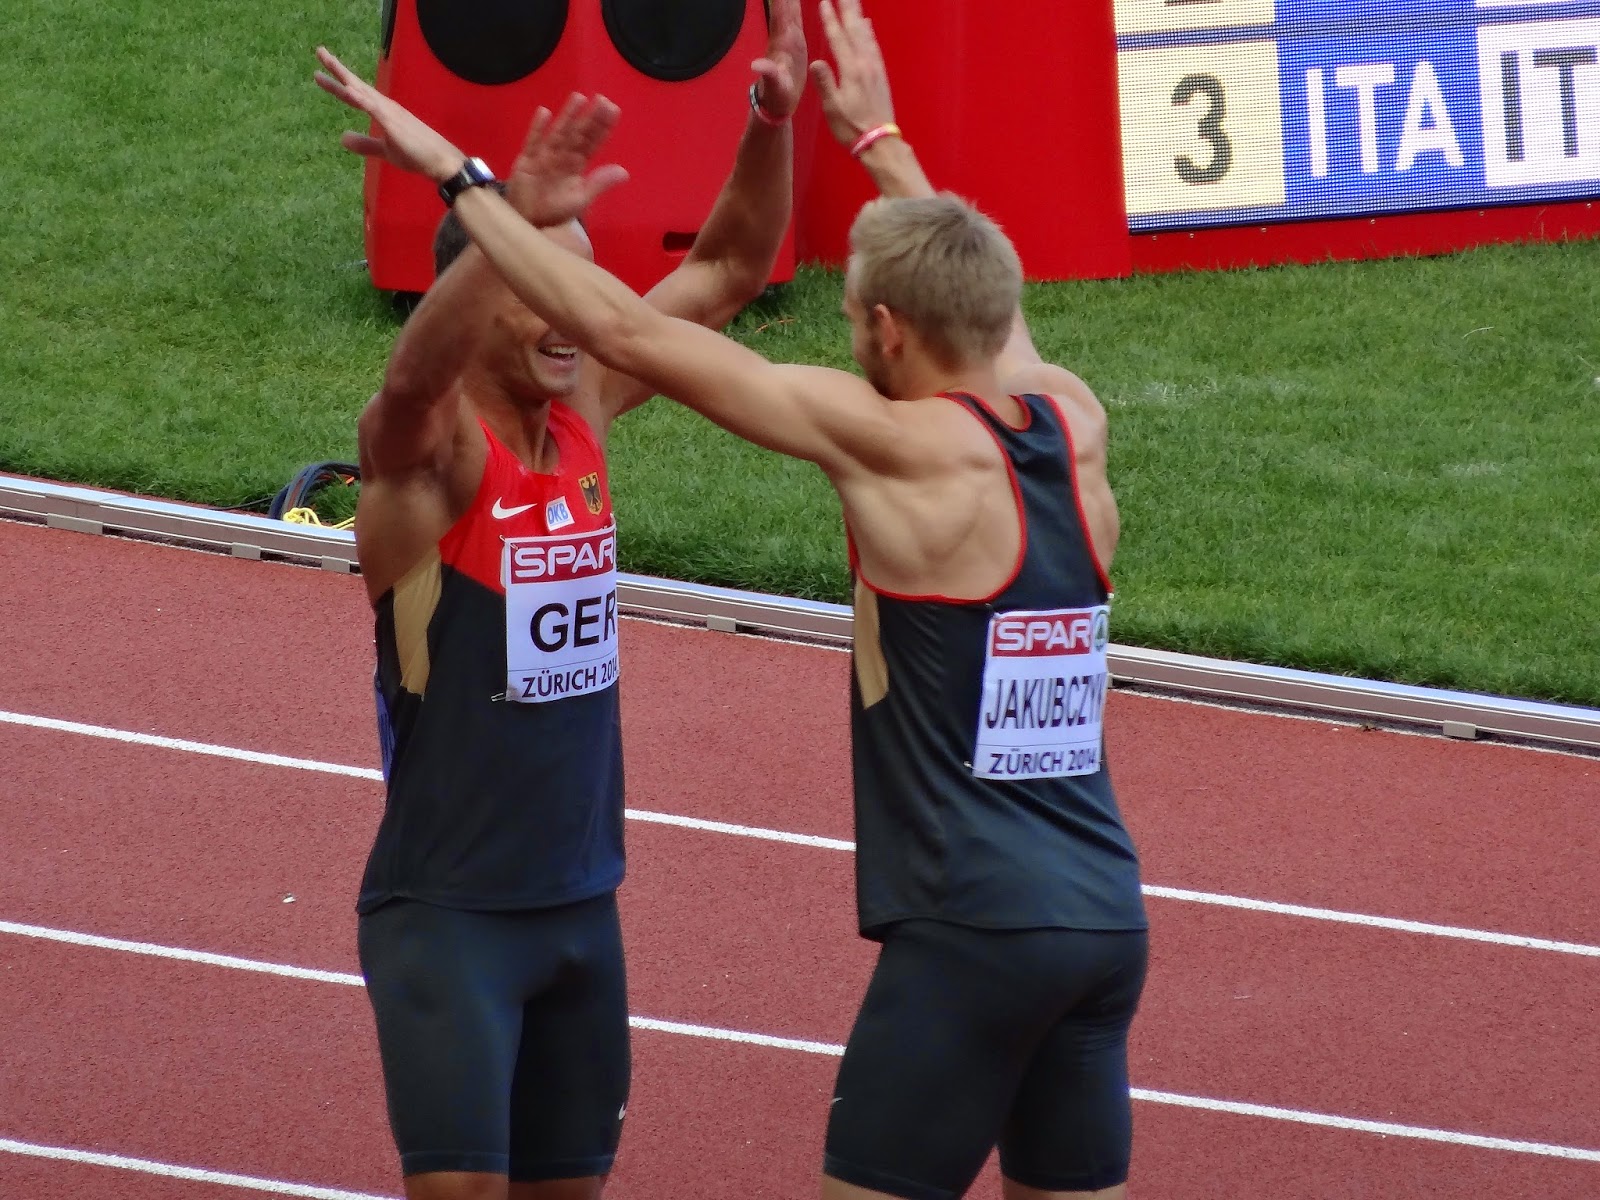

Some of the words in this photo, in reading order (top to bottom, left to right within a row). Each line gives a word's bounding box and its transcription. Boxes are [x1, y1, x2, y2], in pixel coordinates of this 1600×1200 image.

[1170, 72, 1234, 187] 3
[1305, 60, 1466, 179] ITA
[547, 502, 569, 525] DKB
[514, 536, 614, 578] SPAR
[529, 590, 616, 653] GER
[994, 618, 1090, 651] SPAR
[521, 665, 597, 698] ZÜRICH
[989, 747, 1064, 775] ZÜRICH
[1067, 746, 1098, 772] 2014
